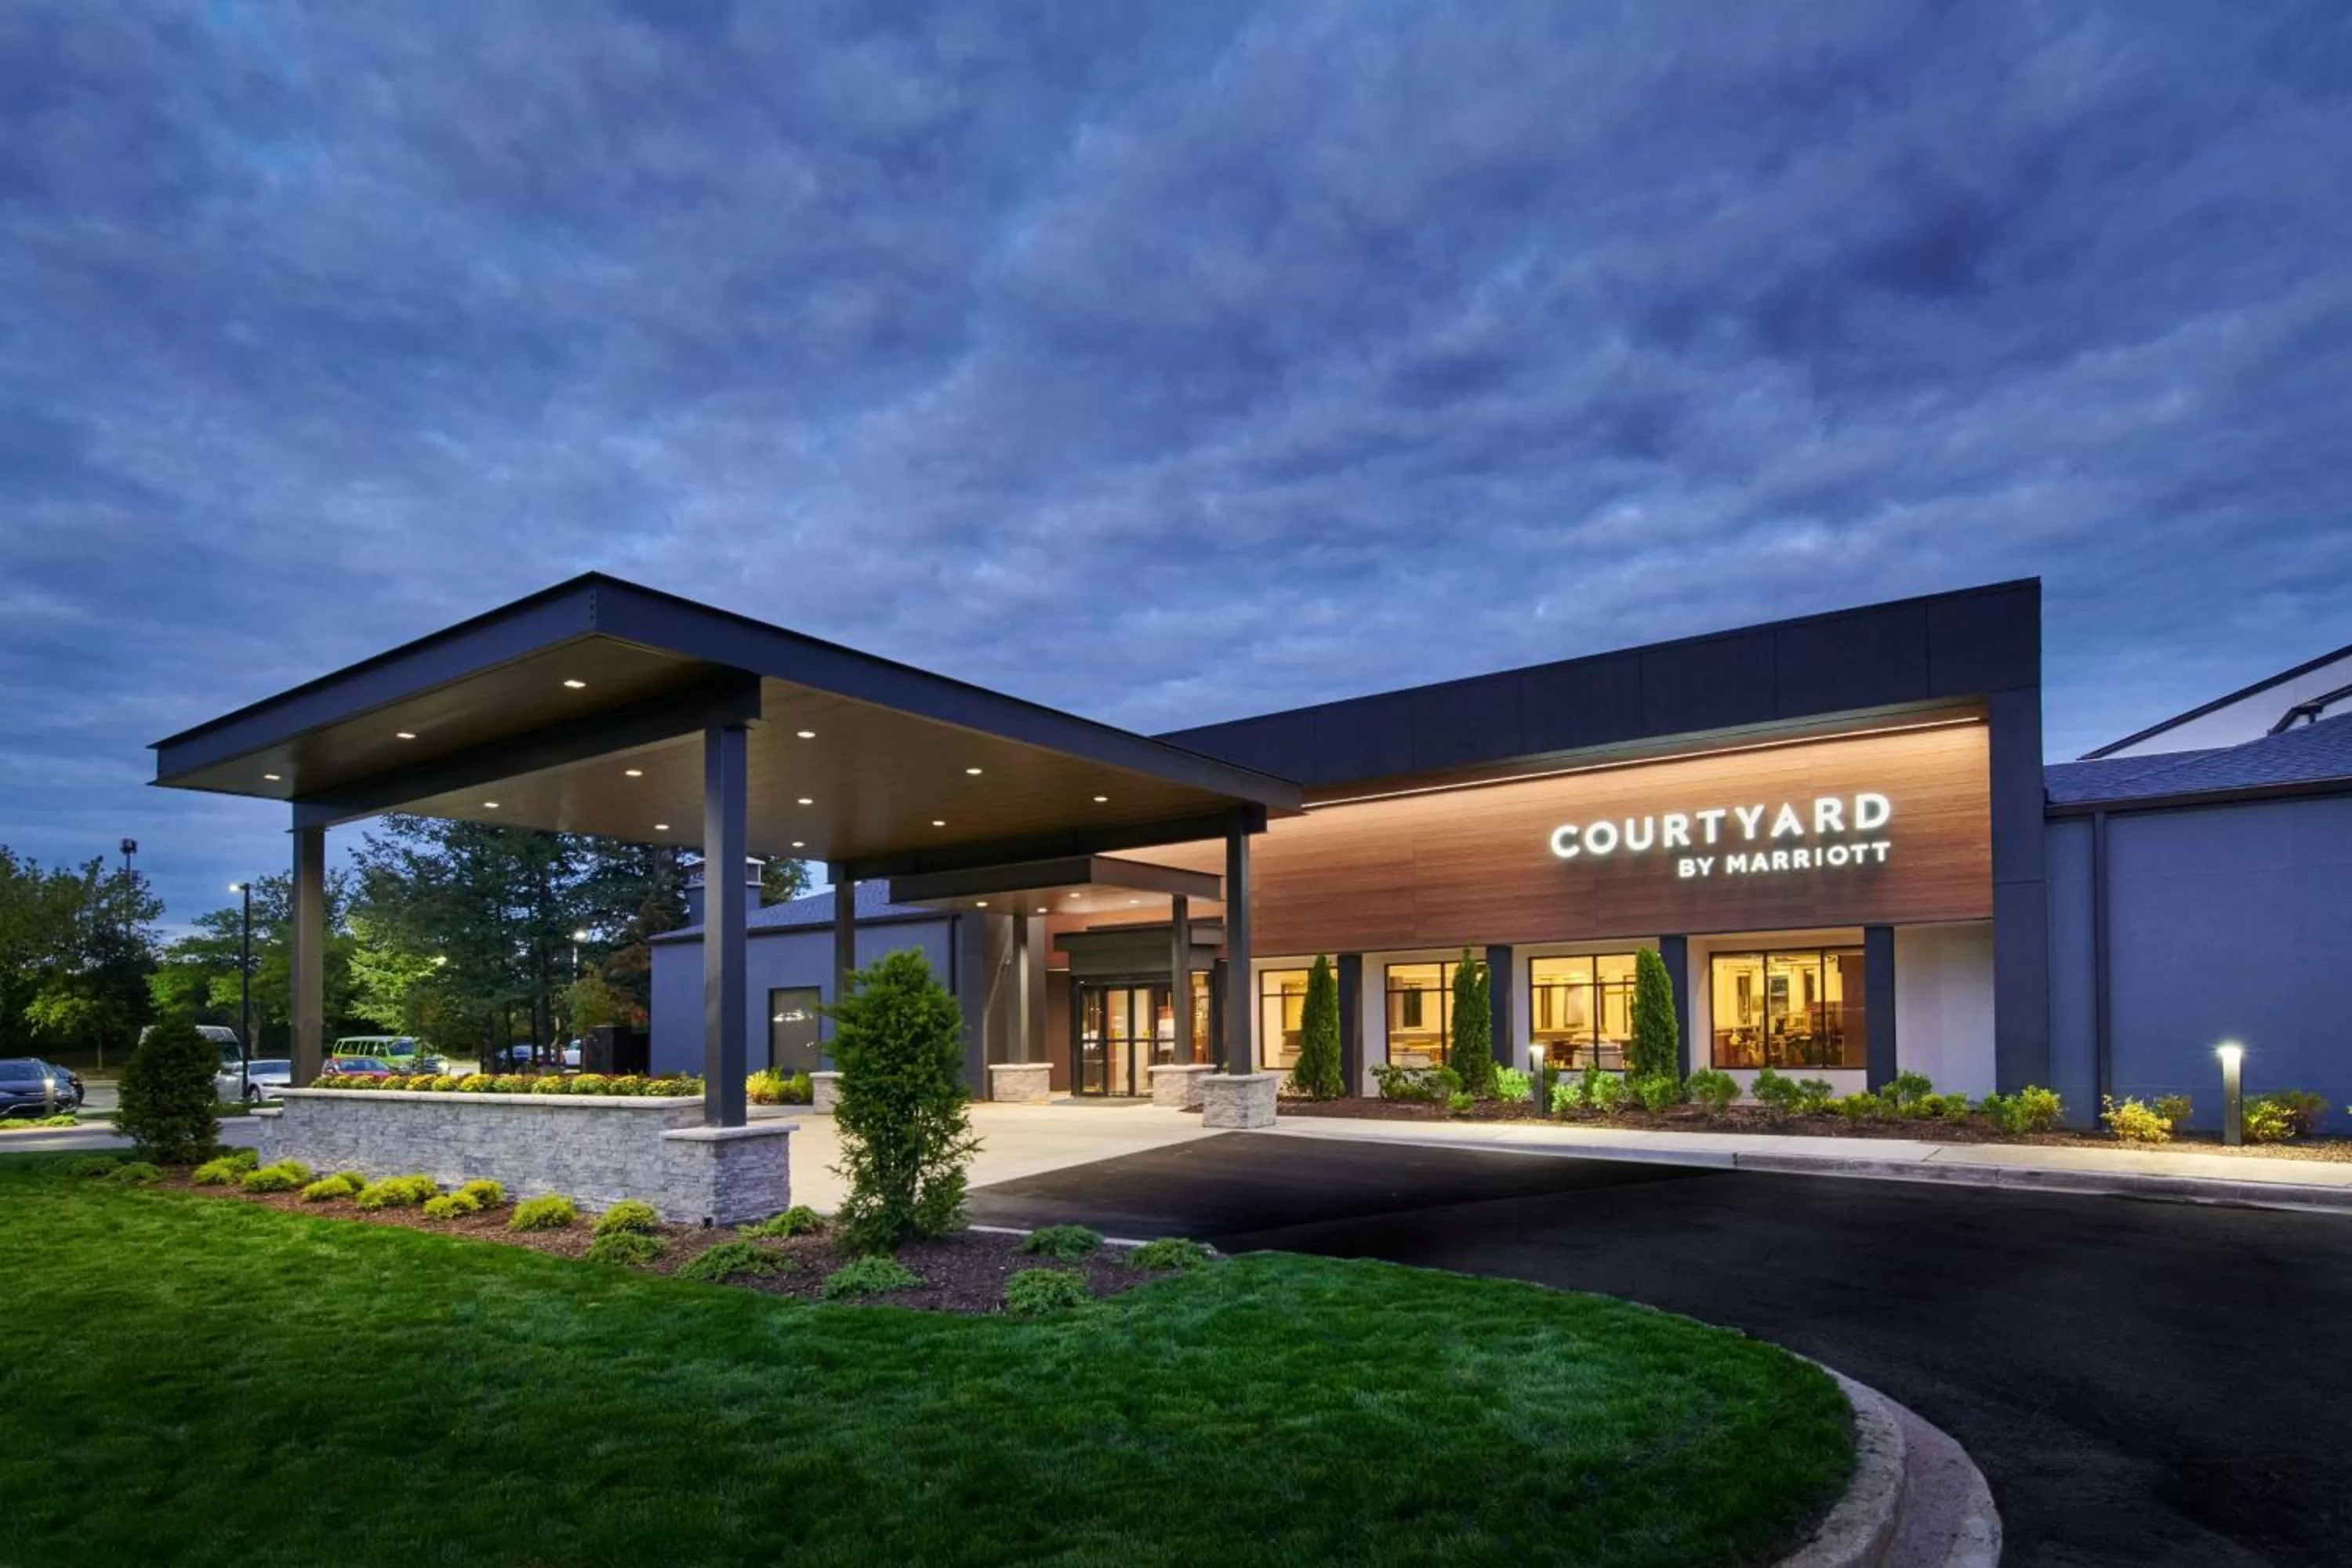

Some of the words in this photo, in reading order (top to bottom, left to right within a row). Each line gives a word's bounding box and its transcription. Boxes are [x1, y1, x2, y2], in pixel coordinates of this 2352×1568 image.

[1549, 792, 1891, 858] COURTYARD
[1678, 857, 1715, 878] BY
[1726, 841, 1891, 874] MARRIOTT
